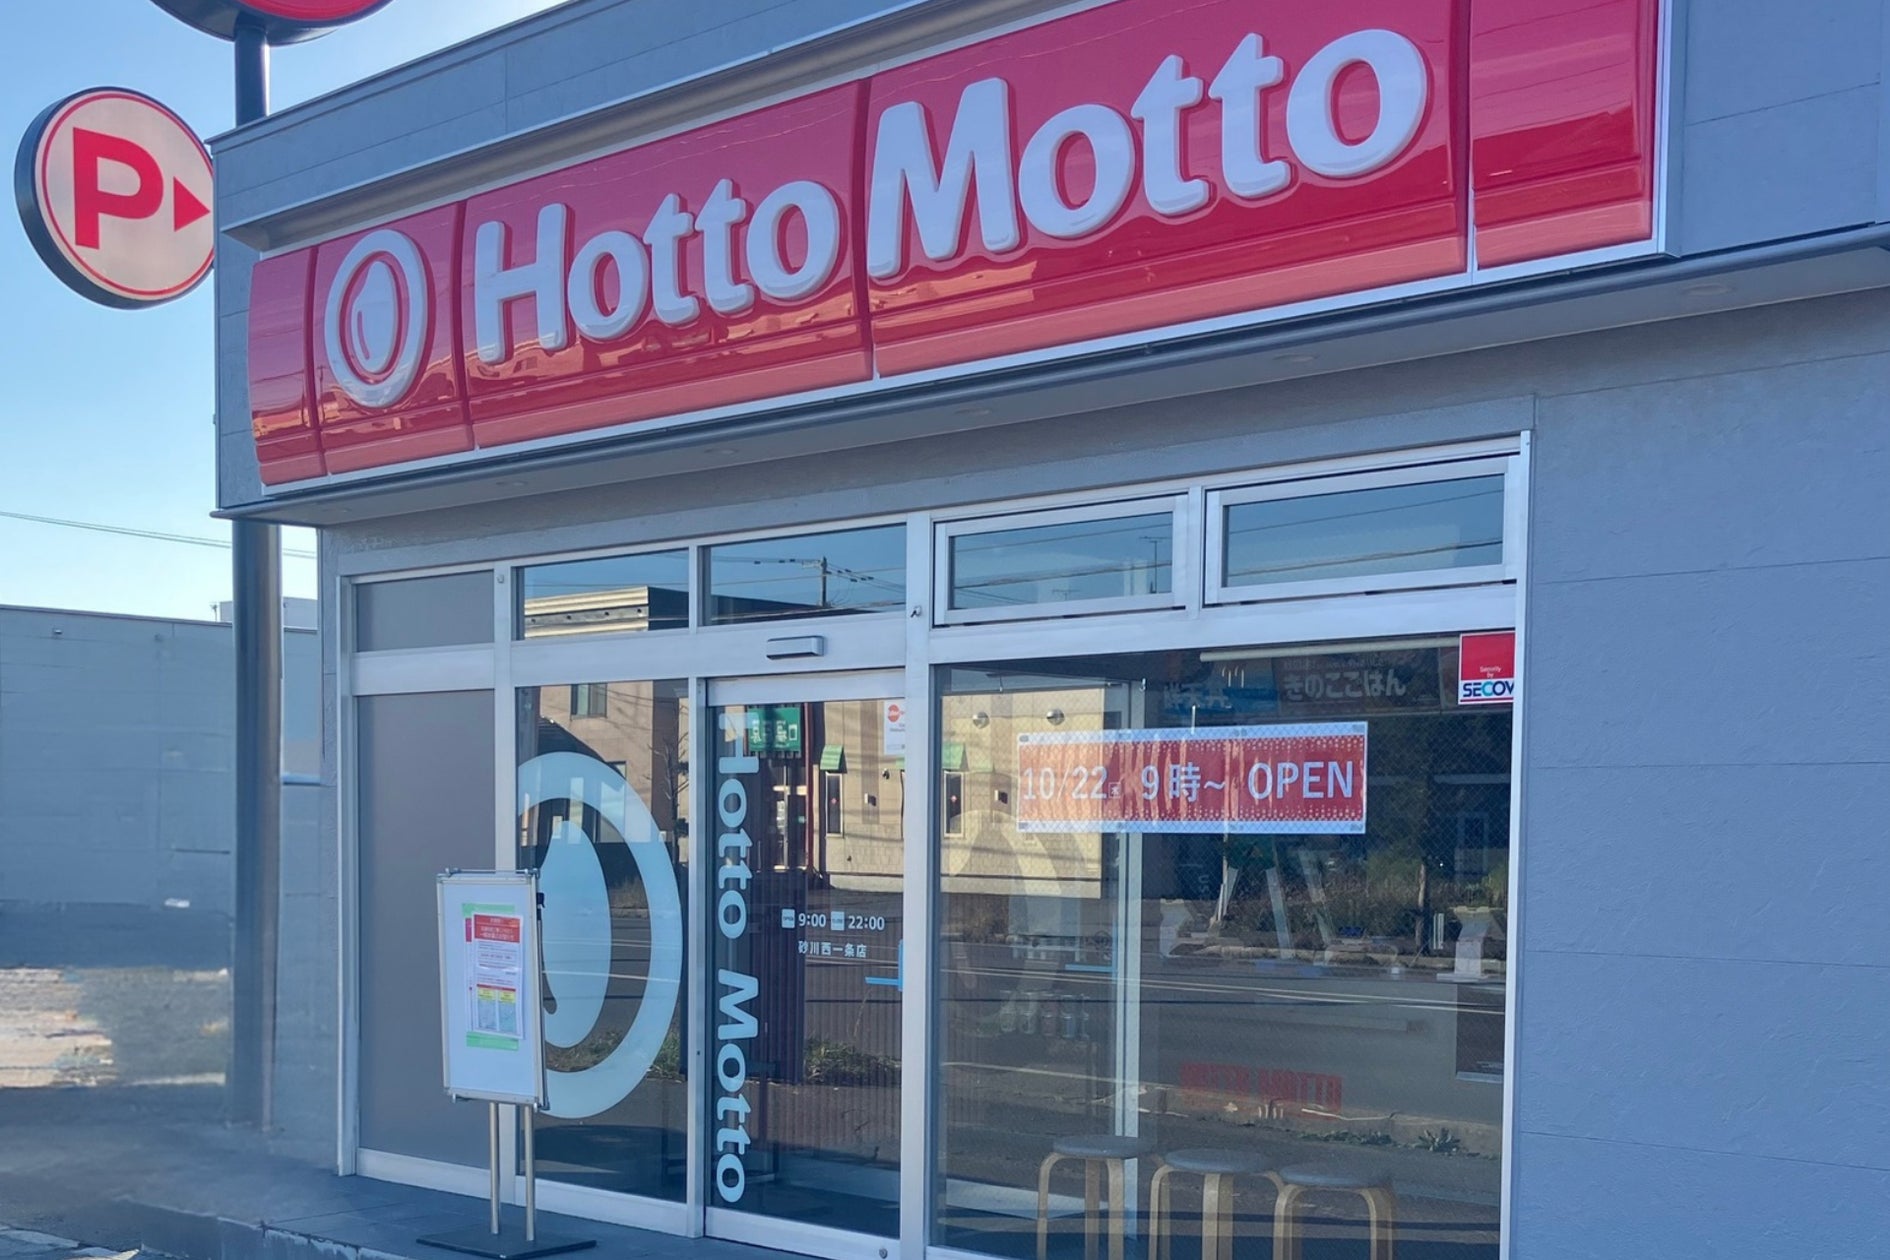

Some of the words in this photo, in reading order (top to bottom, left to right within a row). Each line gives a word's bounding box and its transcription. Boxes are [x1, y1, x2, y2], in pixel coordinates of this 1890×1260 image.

[73, 127, 164, 250] P
[474, 178, 840, 365] Hotto
[867, 29, 1428, 280] Motto
[1283, 668, 1407, 700] きのこごはん
[1247, 760, 1354, 800] OPEN
[718, 712, 760, 939] Hotto
[798, 912, 827, 928] 9:00
[847, 915, 885, 931] 22:00
[798, 940, 867, 958] 砂川西一条店
[716, 968, 759, 1203] Motto
